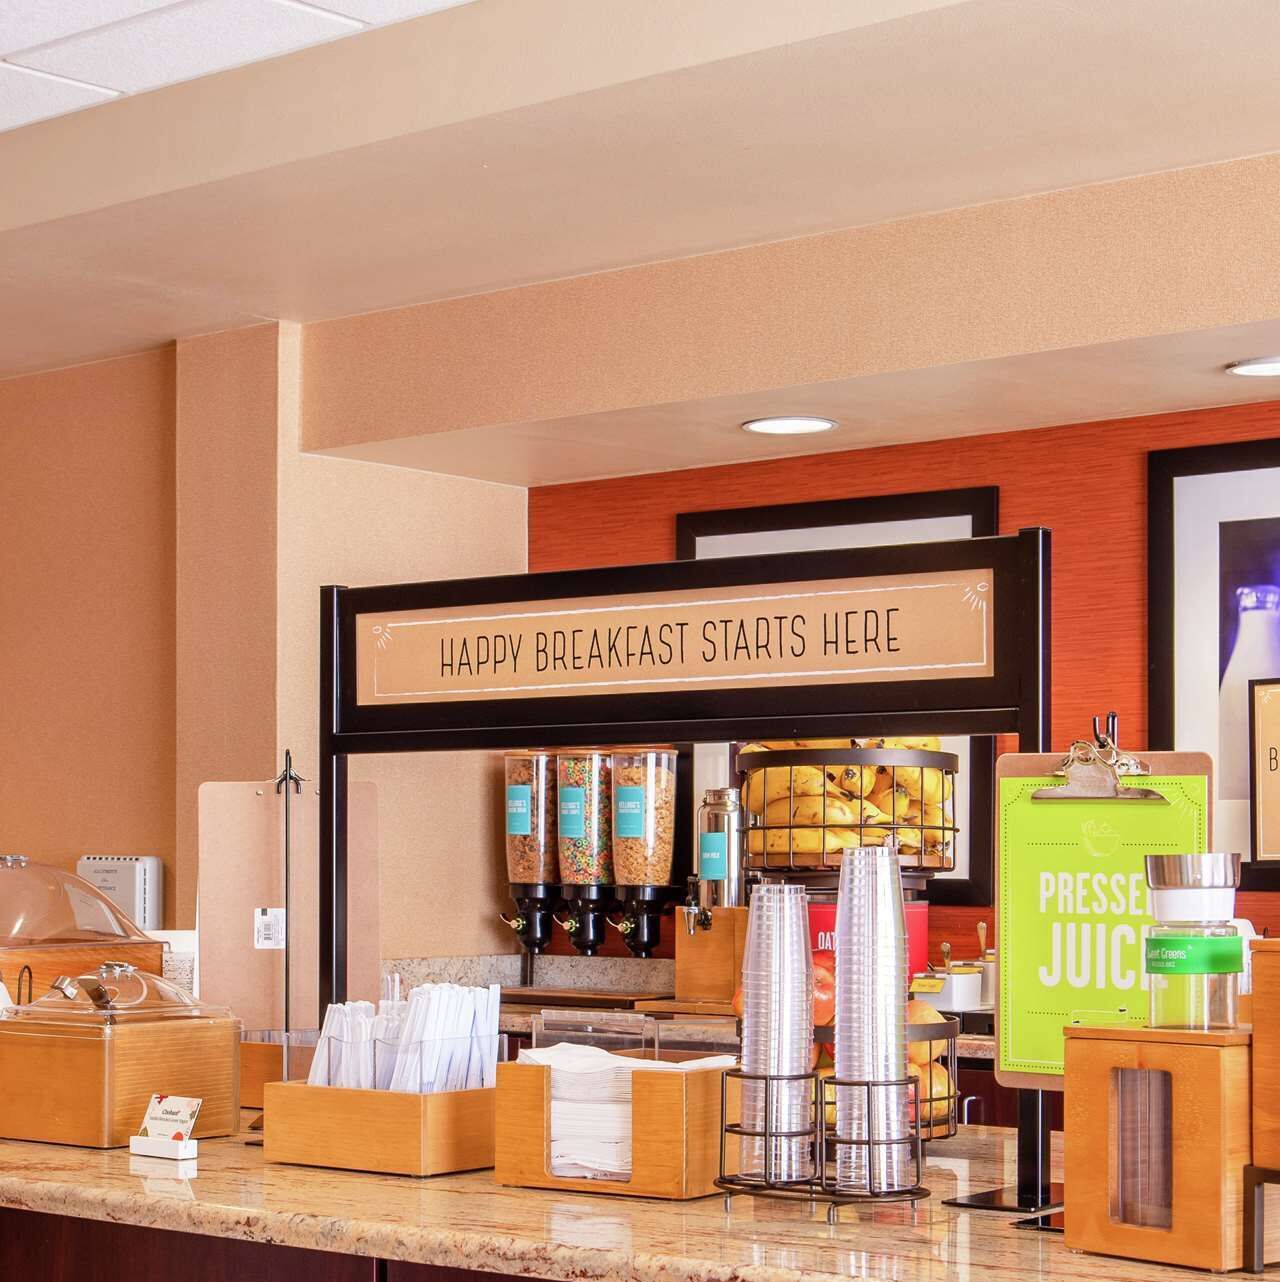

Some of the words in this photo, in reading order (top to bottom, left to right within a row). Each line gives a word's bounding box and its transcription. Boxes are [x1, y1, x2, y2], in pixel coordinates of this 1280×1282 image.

[440, 633, 522, 678] HAPPY
[535, 622, 689, 673] BREAKFAST
[702, 614, 807, 663] STARTS
[823, 607, 901, 657] HERE
[1160, 946, 1187, 961] Greens
